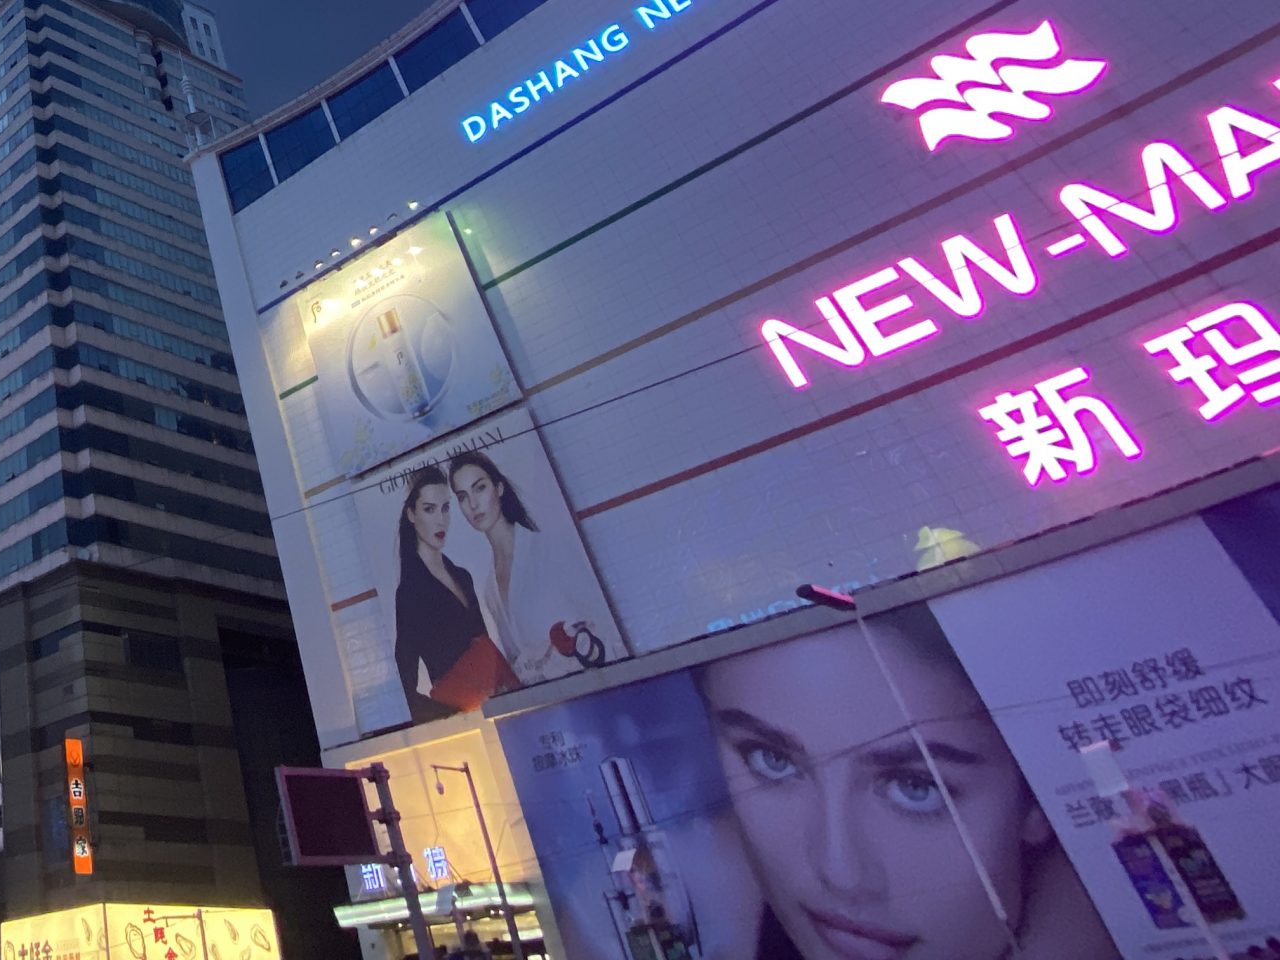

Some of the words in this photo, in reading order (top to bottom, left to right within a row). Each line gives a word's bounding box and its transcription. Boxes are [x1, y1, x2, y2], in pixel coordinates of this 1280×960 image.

[460, 23, 630, 144] DASHANG
[760, 76, 1280, 388] NEW-MA
[1066, 647, 1206, 709] 即刻舒缓
[70, 779, 88, 856] 吉野家
